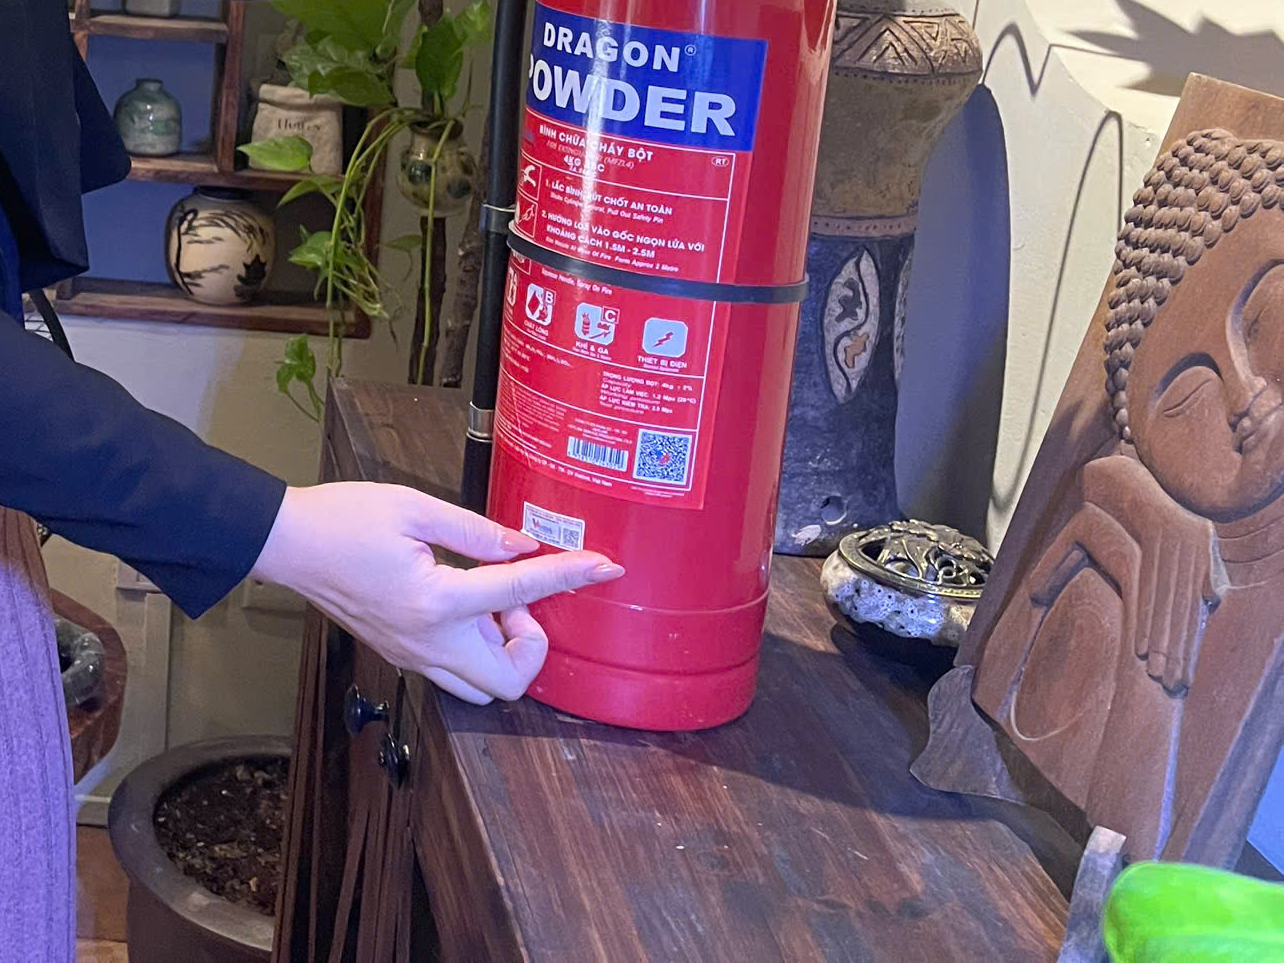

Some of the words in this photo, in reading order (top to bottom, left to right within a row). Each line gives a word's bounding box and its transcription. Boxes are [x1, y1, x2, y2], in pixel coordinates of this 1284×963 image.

[628, 147, 654, 162] BỘT
[603, 196, 628, 208] CHỐT
[630, 202, 644, 210] AN
[646, 204, 673, 215] TOÀN
[591, 224, 611, 236] VÀO
[612, 229, 634, 242] GỐC
[636, 235, 665, 248] NGỌN
[667, 238, 685, 249] LỬA
[632, 247, 656, 258] 2.5M
[545, 290, 554, 304] B
[604, 309, 617, 323] C
